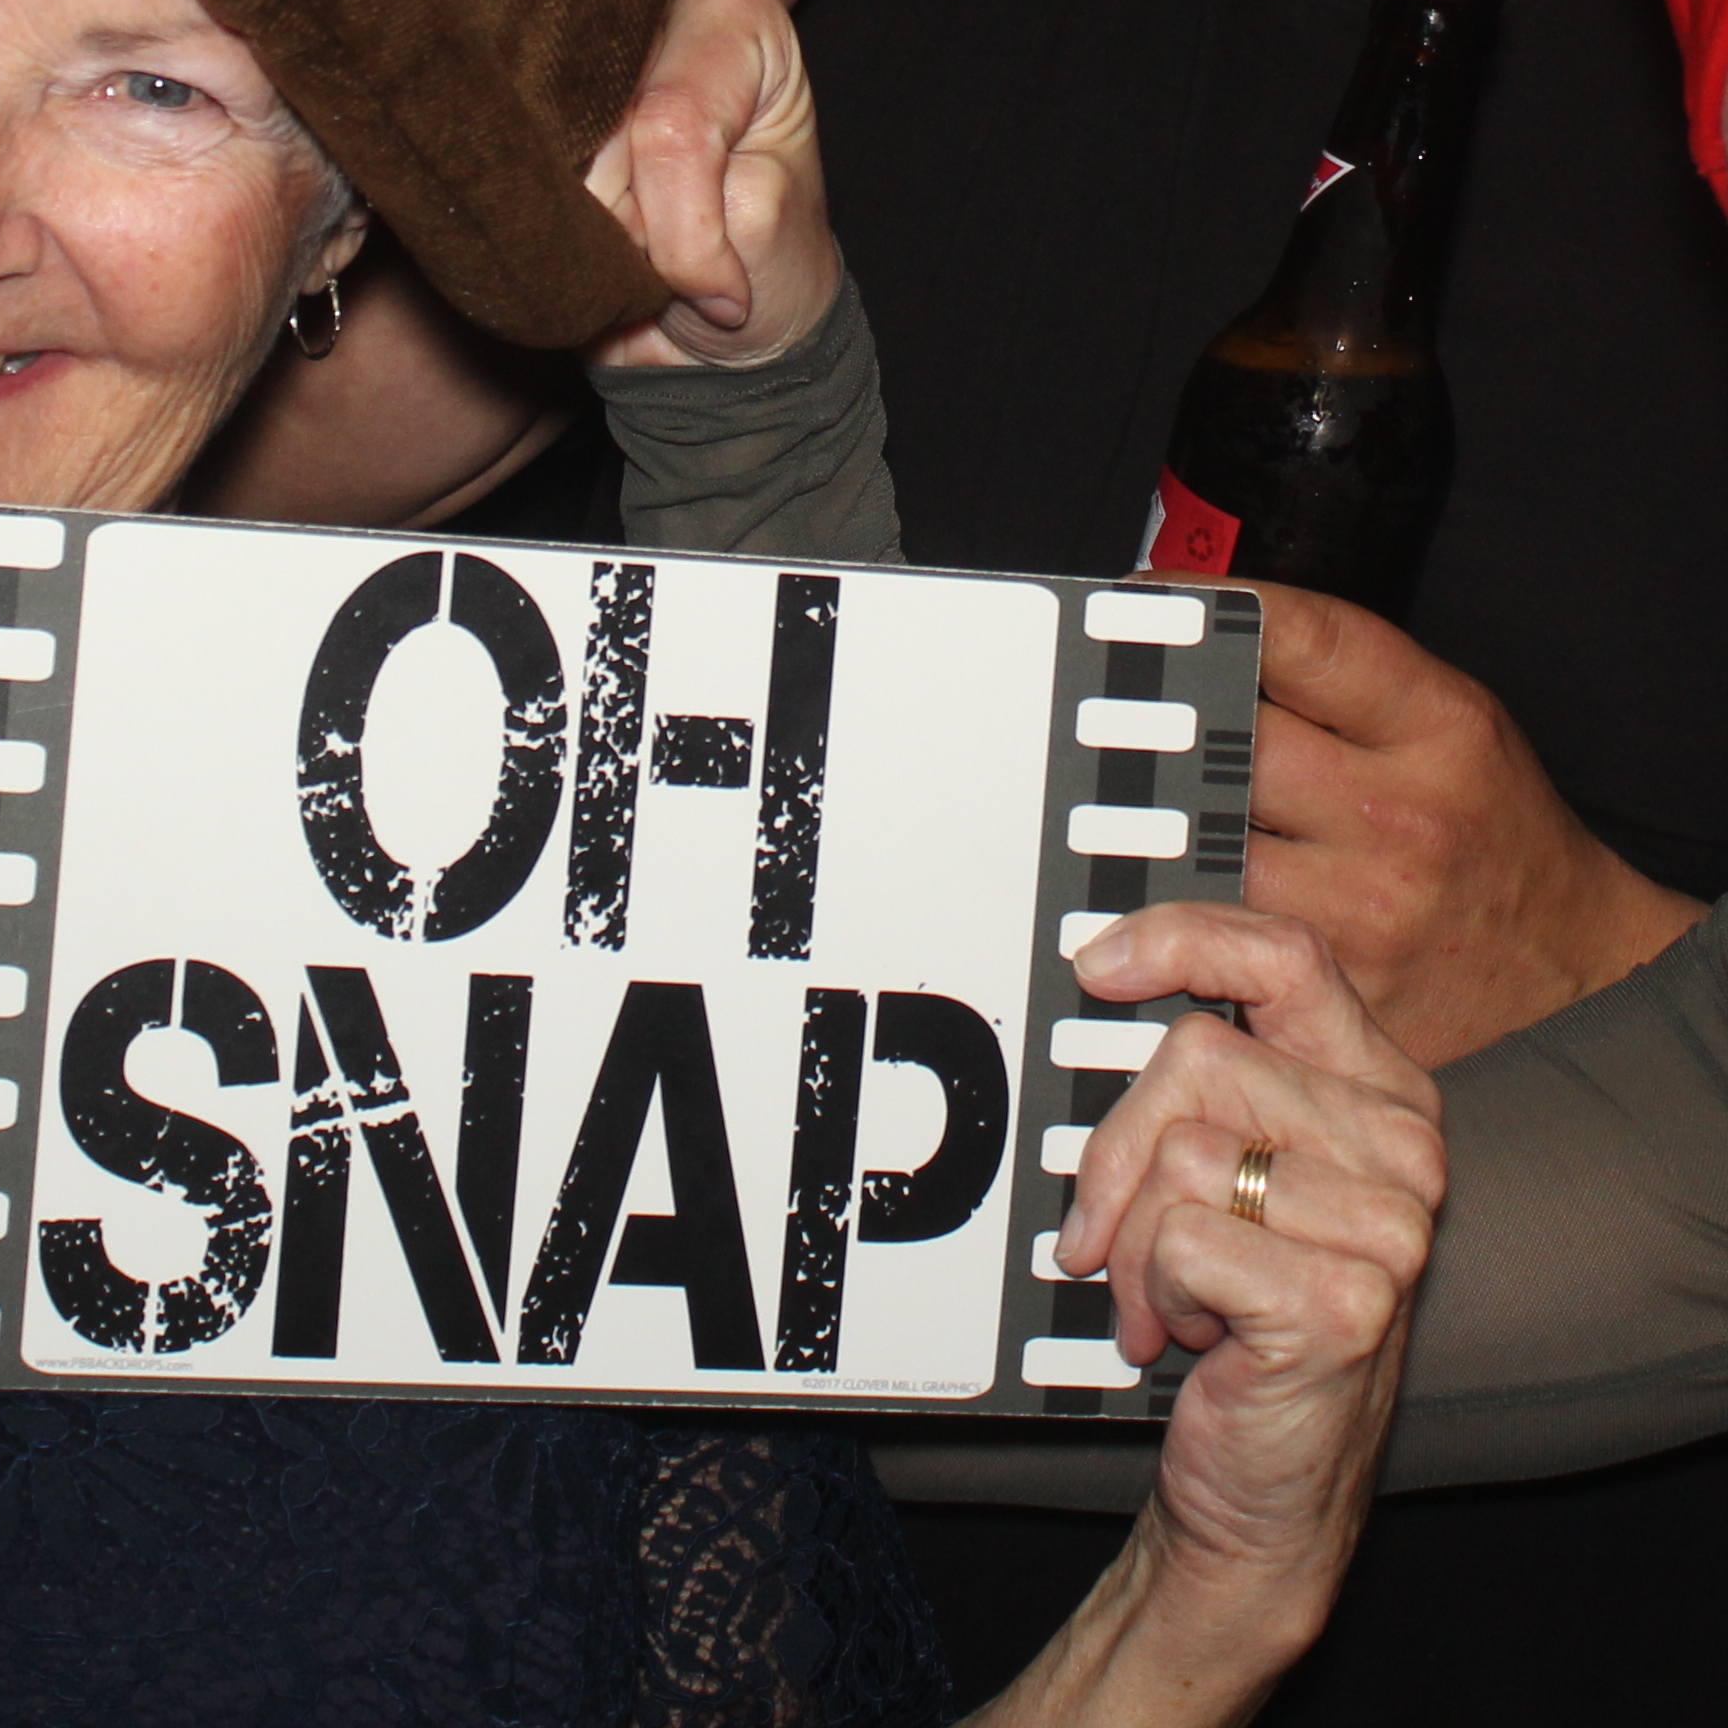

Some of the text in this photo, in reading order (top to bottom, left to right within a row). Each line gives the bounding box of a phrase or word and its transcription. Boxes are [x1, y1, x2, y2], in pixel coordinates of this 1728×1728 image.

[296, 549, 841, 961] OH
[37, 957, 1010, 1373] SNAP
[842, 1379, 889, 1390] CLOVER
[892, 1380, 918, 1392] MILL
[922, 1381, 981, 1394] GRAPHICS
